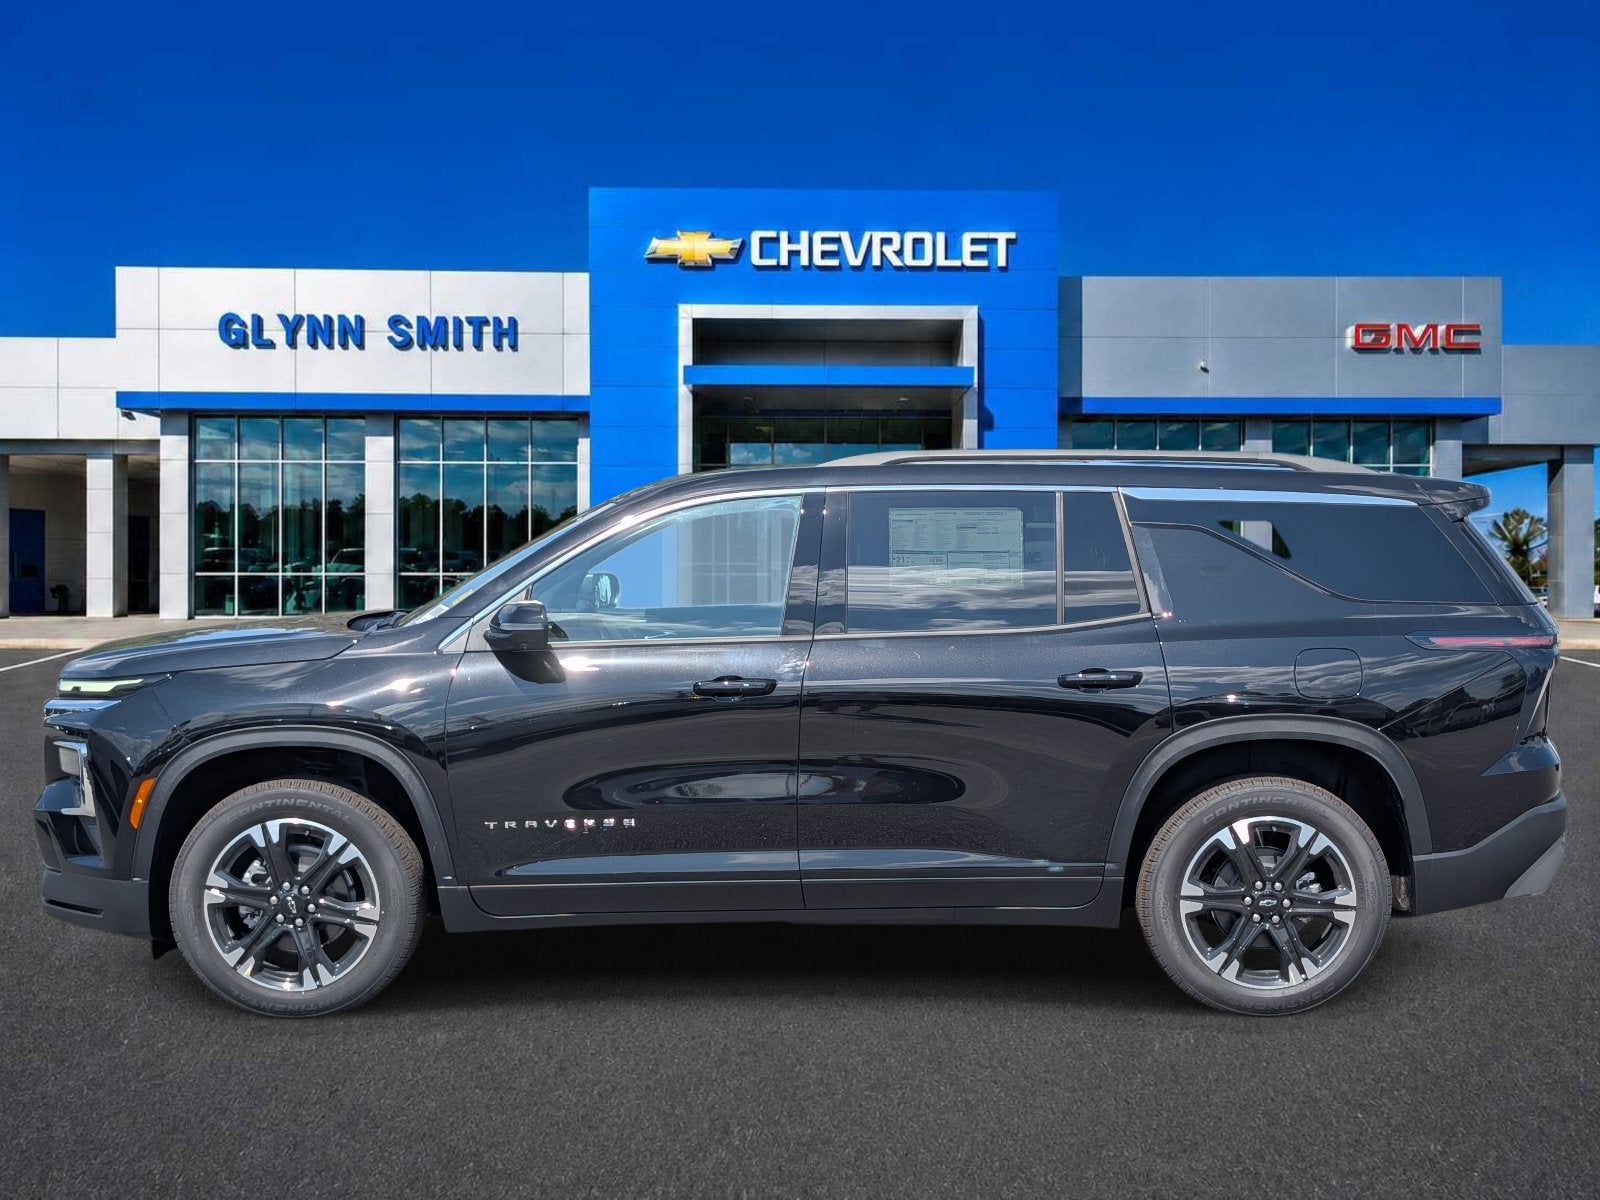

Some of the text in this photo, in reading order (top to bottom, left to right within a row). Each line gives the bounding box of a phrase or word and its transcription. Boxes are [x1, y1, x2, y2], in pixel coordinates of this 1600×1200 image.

[750, 230, 1017, 268] CHEVROLET
[218, 312, 518, 352] GLYNN SMITH
[1349, 323, 1481, 352] GMC
[226, 798, 352, 825] CONTINENTAL
[1202, 795, 1329, 825] CONTINEN
